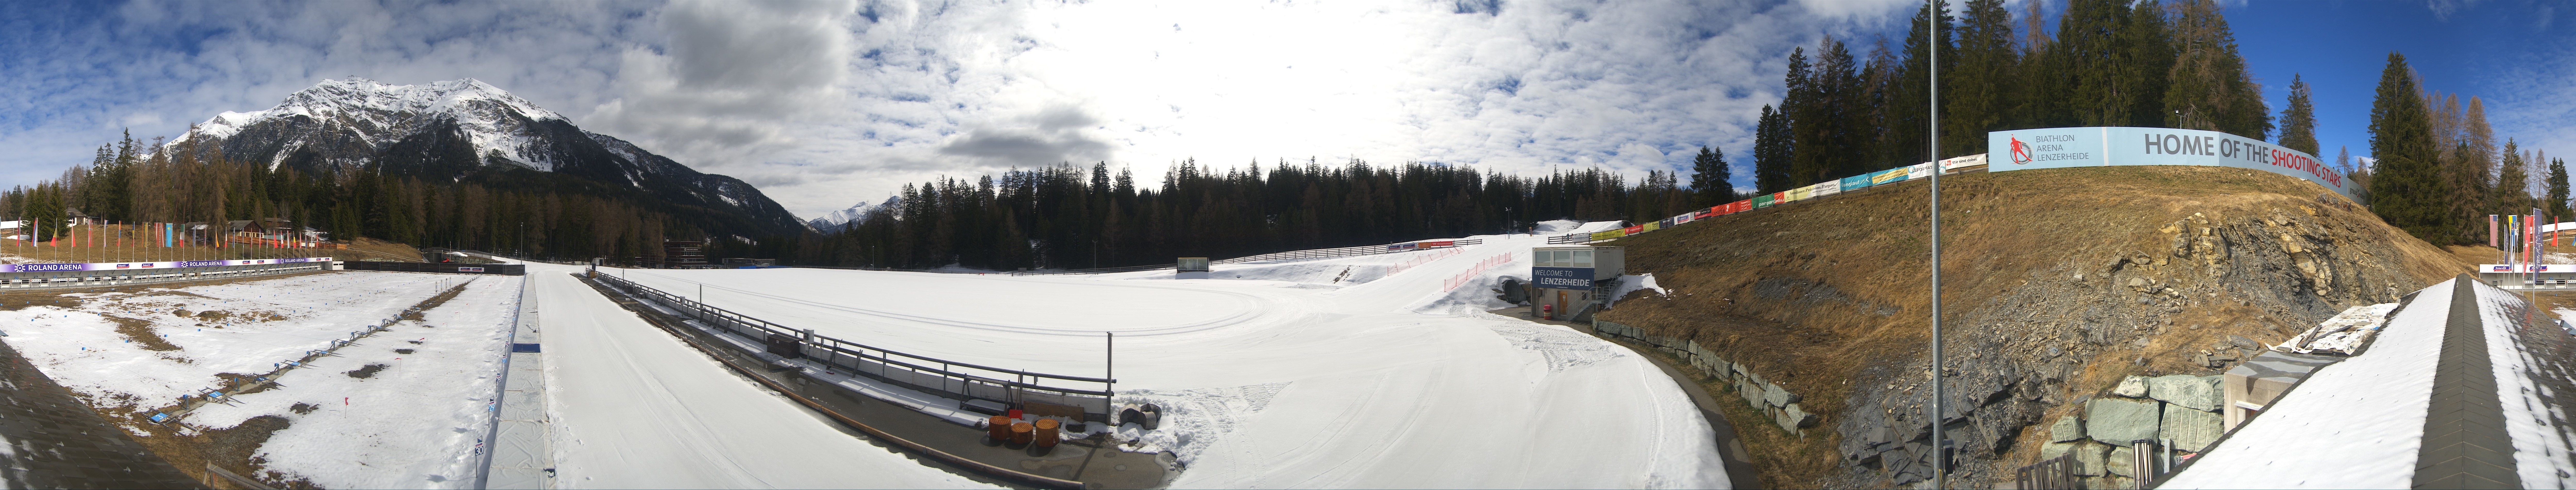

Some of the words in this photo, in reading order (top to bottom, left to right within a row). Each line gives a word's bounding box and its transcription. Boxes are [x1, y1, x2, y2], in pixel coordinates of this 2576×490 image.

[2036, 135, 2074, 143] BIATHLON
[2037, 152, 2089, 161] LENZERHEIDE
[2145, 134, 2214, 156] HOME
[2220, 138, 2240, 158] OF
[2244, 142, 2268, 164] THE
[2272, 149, 2320, 177] SHOOTING
[2322, 167, 2341, 188] STARS
[1759, 198, 1784, 207] parpanbau
[1541, 278, 1590, 286] LENZERHEIDE
[476, 446, 483, 455] 30
